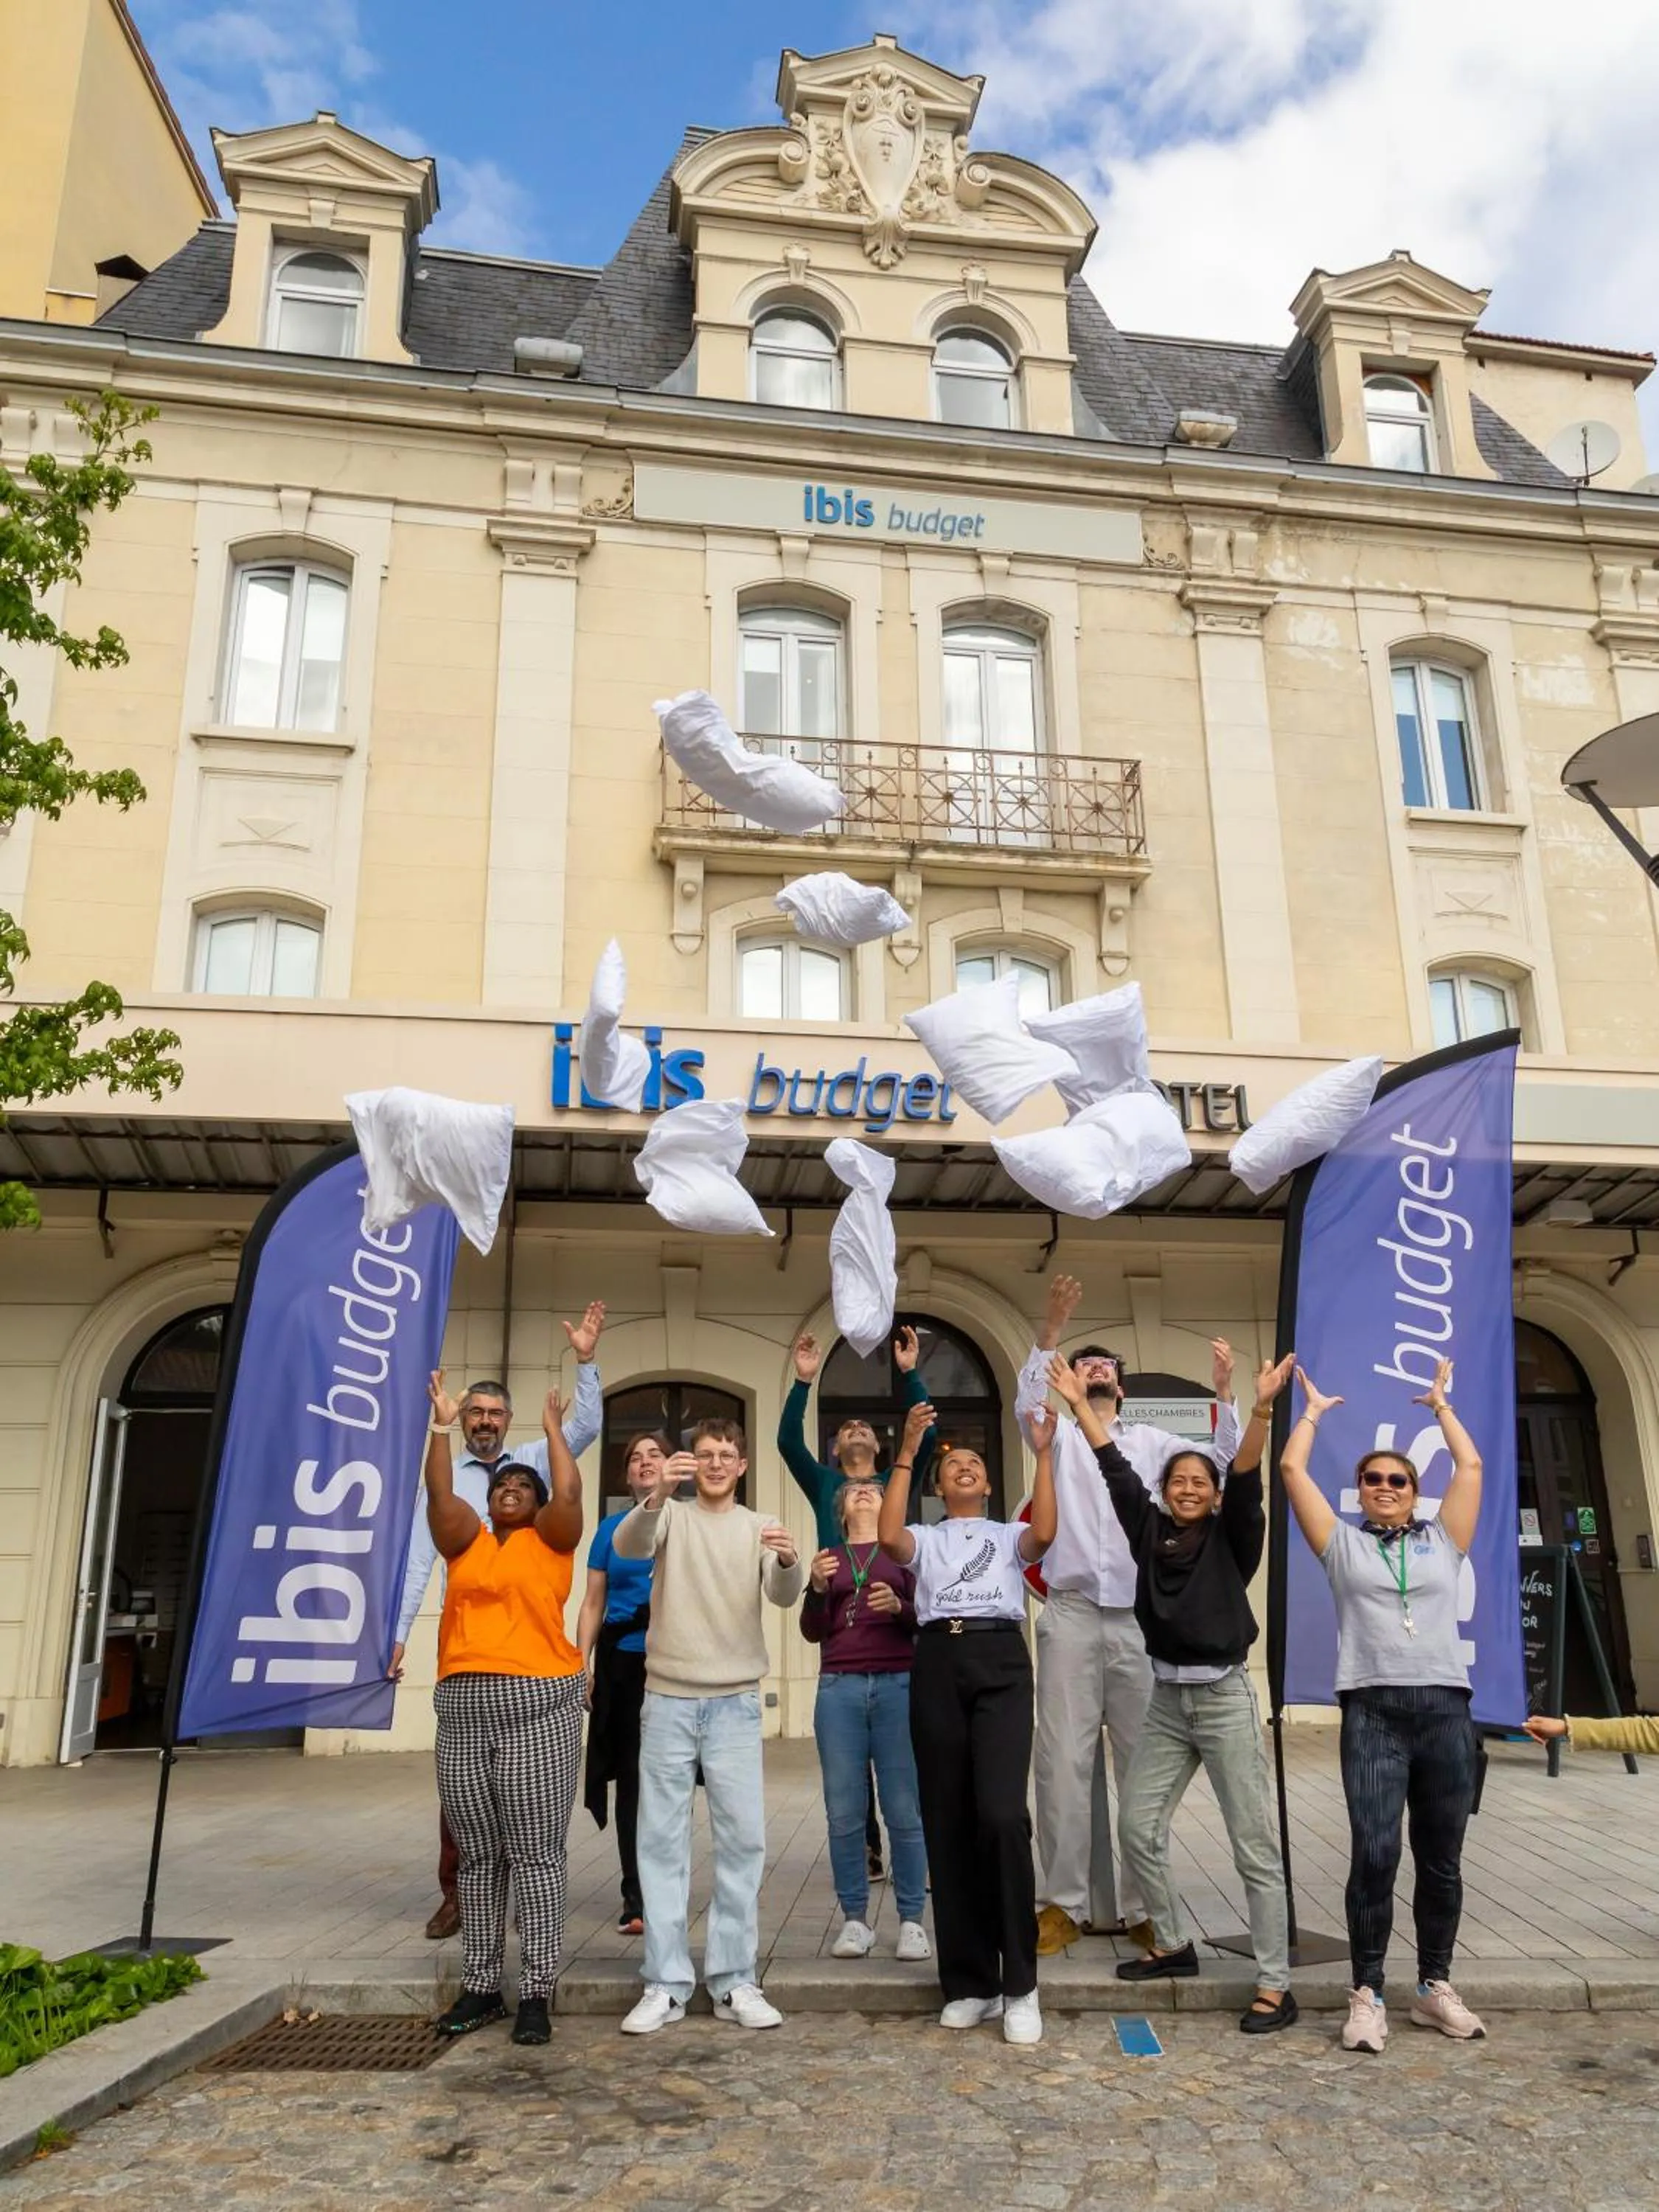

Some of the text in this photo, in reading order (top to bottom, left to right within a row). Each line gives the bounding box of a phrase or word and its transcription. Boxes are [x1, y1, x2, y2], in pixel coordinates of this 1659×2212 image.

[804, 484, 985, 542] ibis budget
[552, 1023, 706, 1110] iis
[1150, 1079, 1253, 1132] TEL
[1374, 1123, 1473, 1394] budget
[231, 1188, 421, 1684] ibis budge
[1148, 1409, 1205, 1418] CHAMBRES
[936, 1586, 1003, 1607] gold rush
